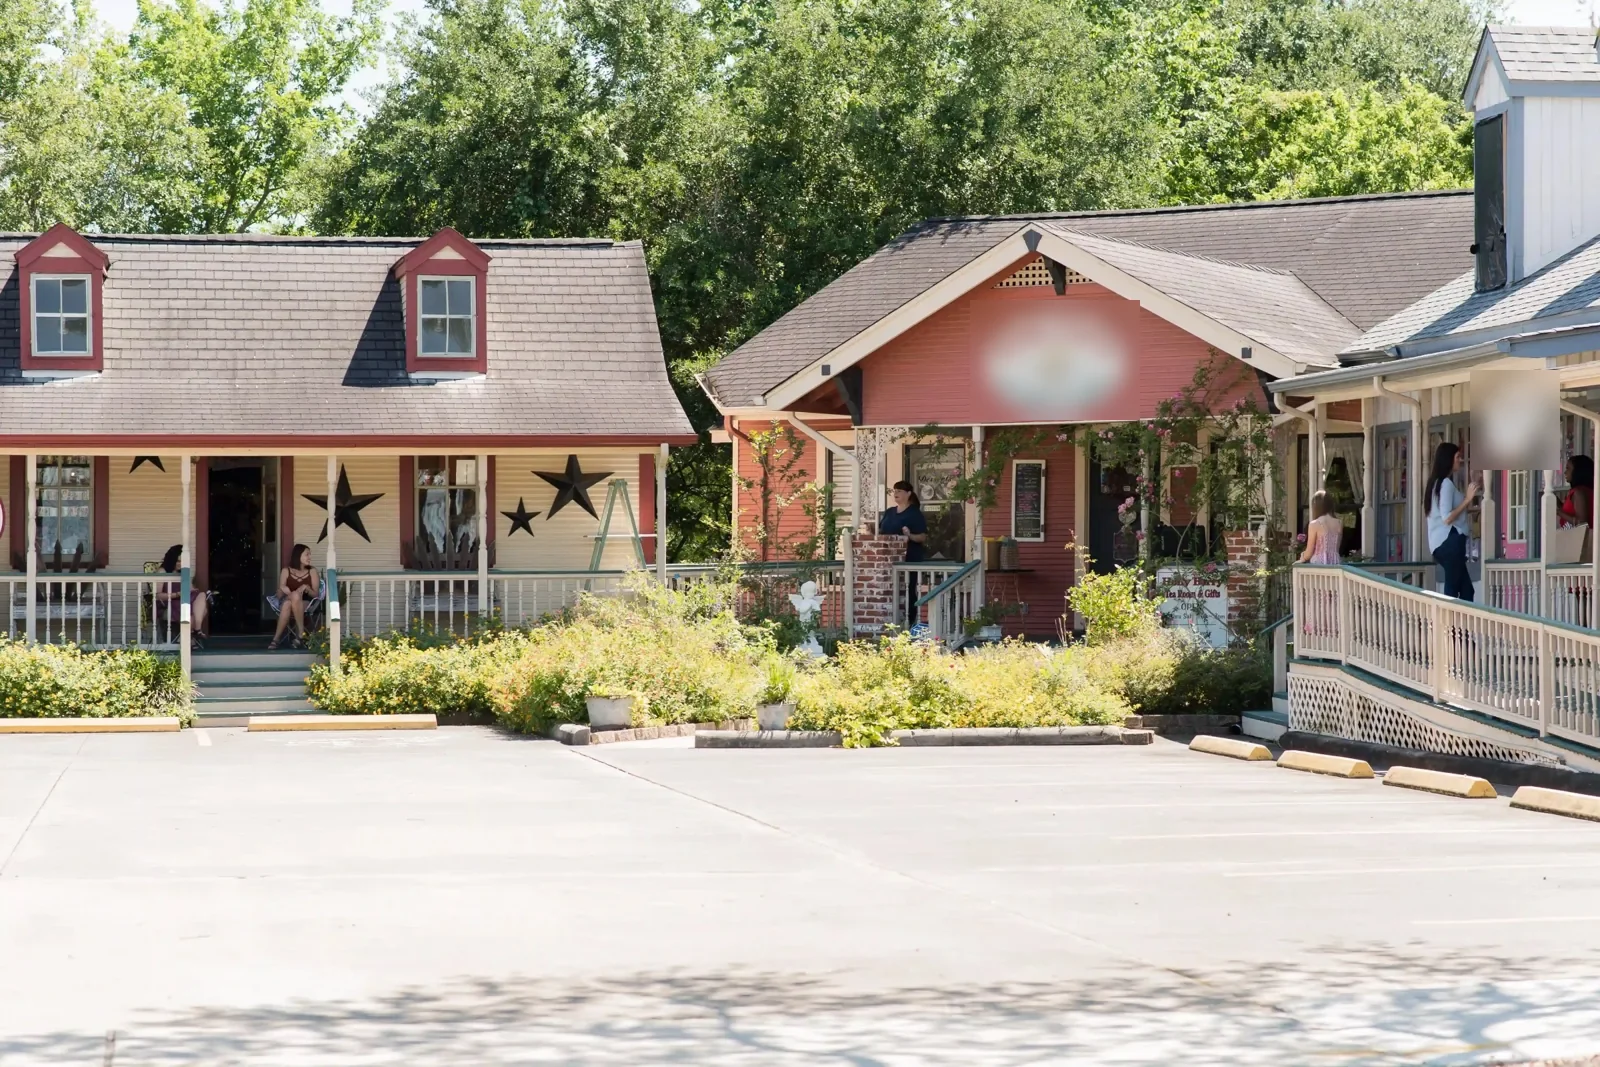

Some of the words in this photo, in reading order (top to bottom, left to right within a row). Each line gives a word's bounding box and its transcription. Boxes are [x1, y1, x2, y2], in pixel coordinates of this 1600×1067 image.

[1166, 590, 1176, 598] Tea
[1177, 590, 1196, 598] Room
[1198, 589, 1204, 598] &
[1205, 589, 1220, 598] Gifts
